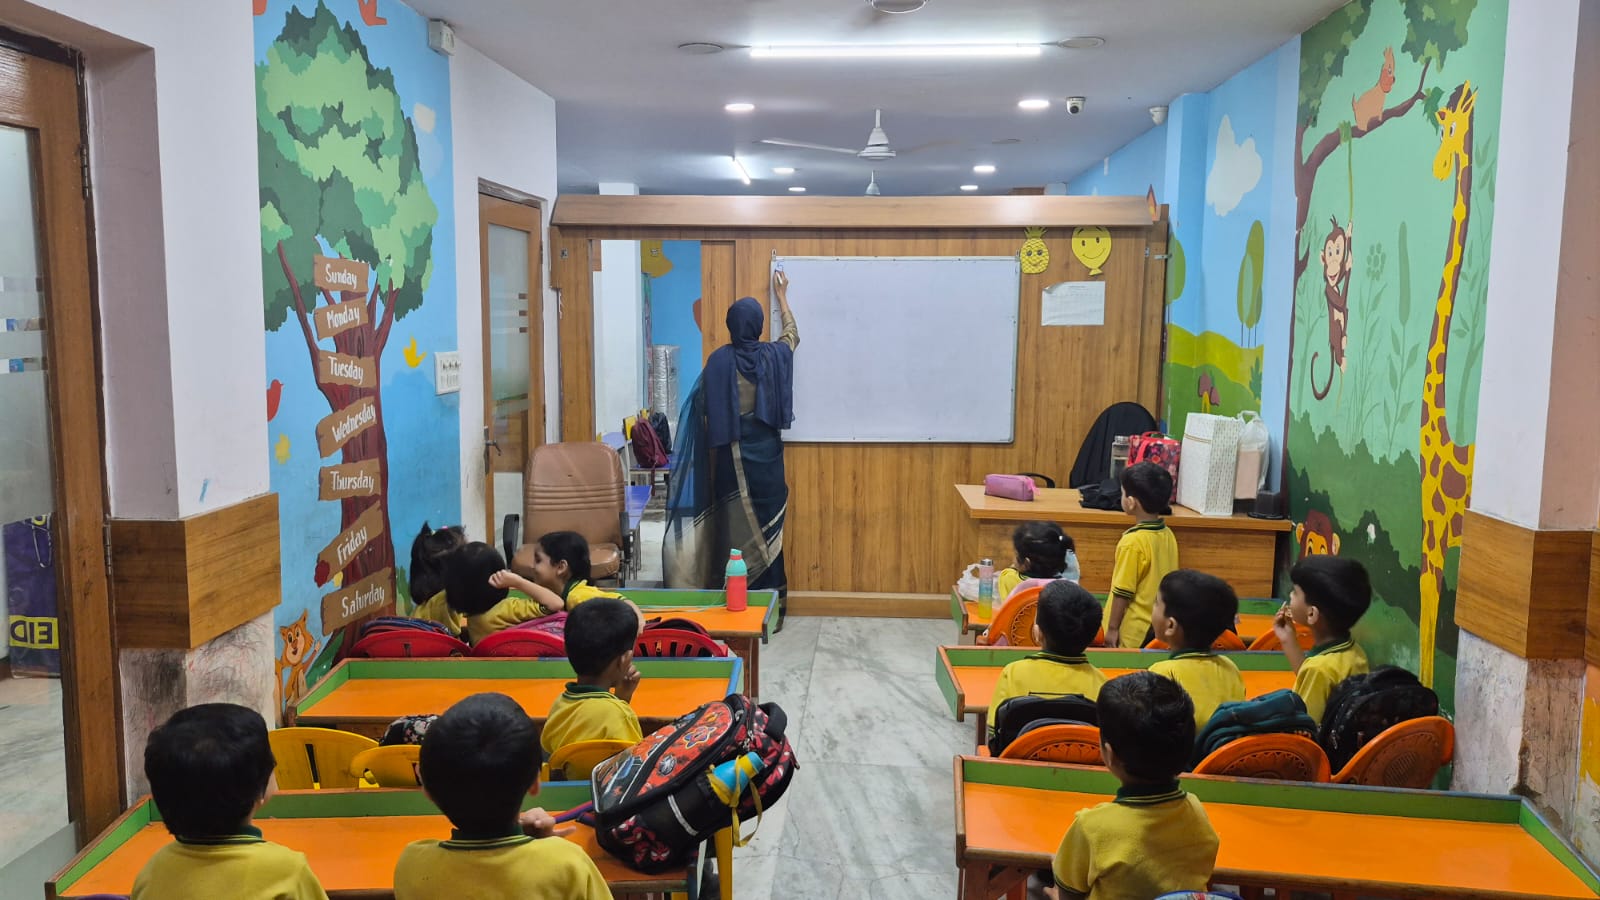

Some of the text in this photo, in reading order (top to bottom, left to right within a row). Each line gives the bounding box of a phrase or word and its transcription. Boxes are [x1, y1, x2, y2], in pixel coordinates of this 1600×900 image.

[325, 264, 357, 290] Sunday
[327, 306, 360, 329] Monday
[328, 356, 363, 384] Tuesday
[332, 403, 376, 442] Wednesday
[330, 470, 375, 494] Thursday
[336, 526, 368, 566] Friday
[342, 584, 384, 618] Saturday
